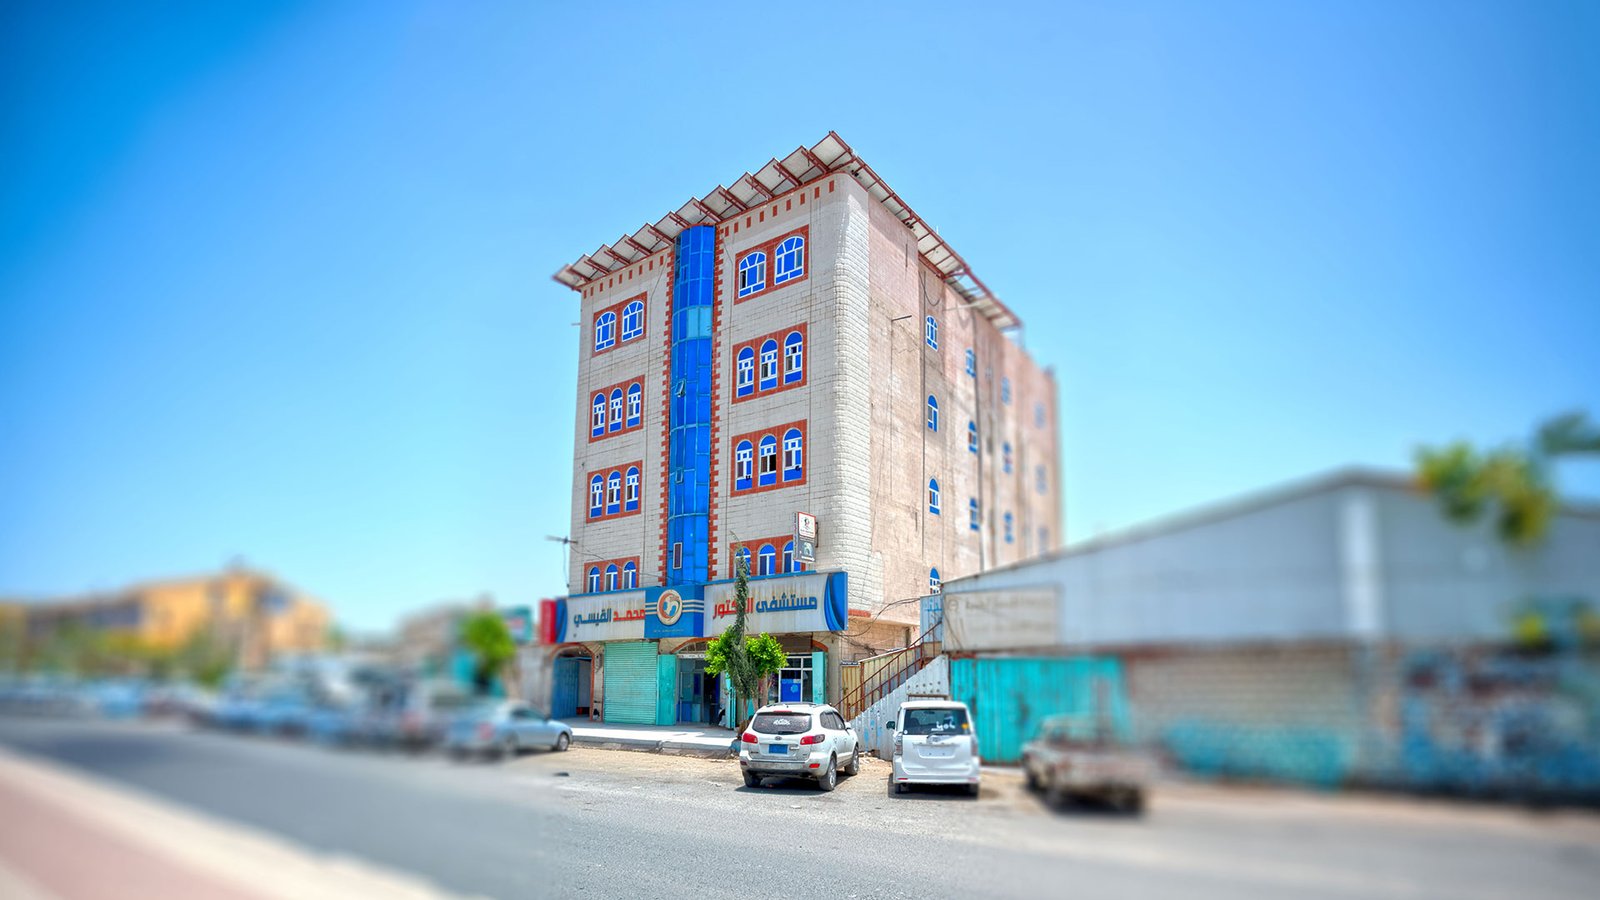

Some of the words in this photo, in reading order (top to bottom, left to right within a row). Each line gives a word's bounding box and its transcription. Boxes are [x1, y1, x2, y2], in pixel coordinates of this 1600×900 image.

[713, 597, 754, 620] الكتور
[756, 592, 817, 613] مستشفى
[574, 608, 612, 627] القيسي
[613, 609, 646, 622] محمد
